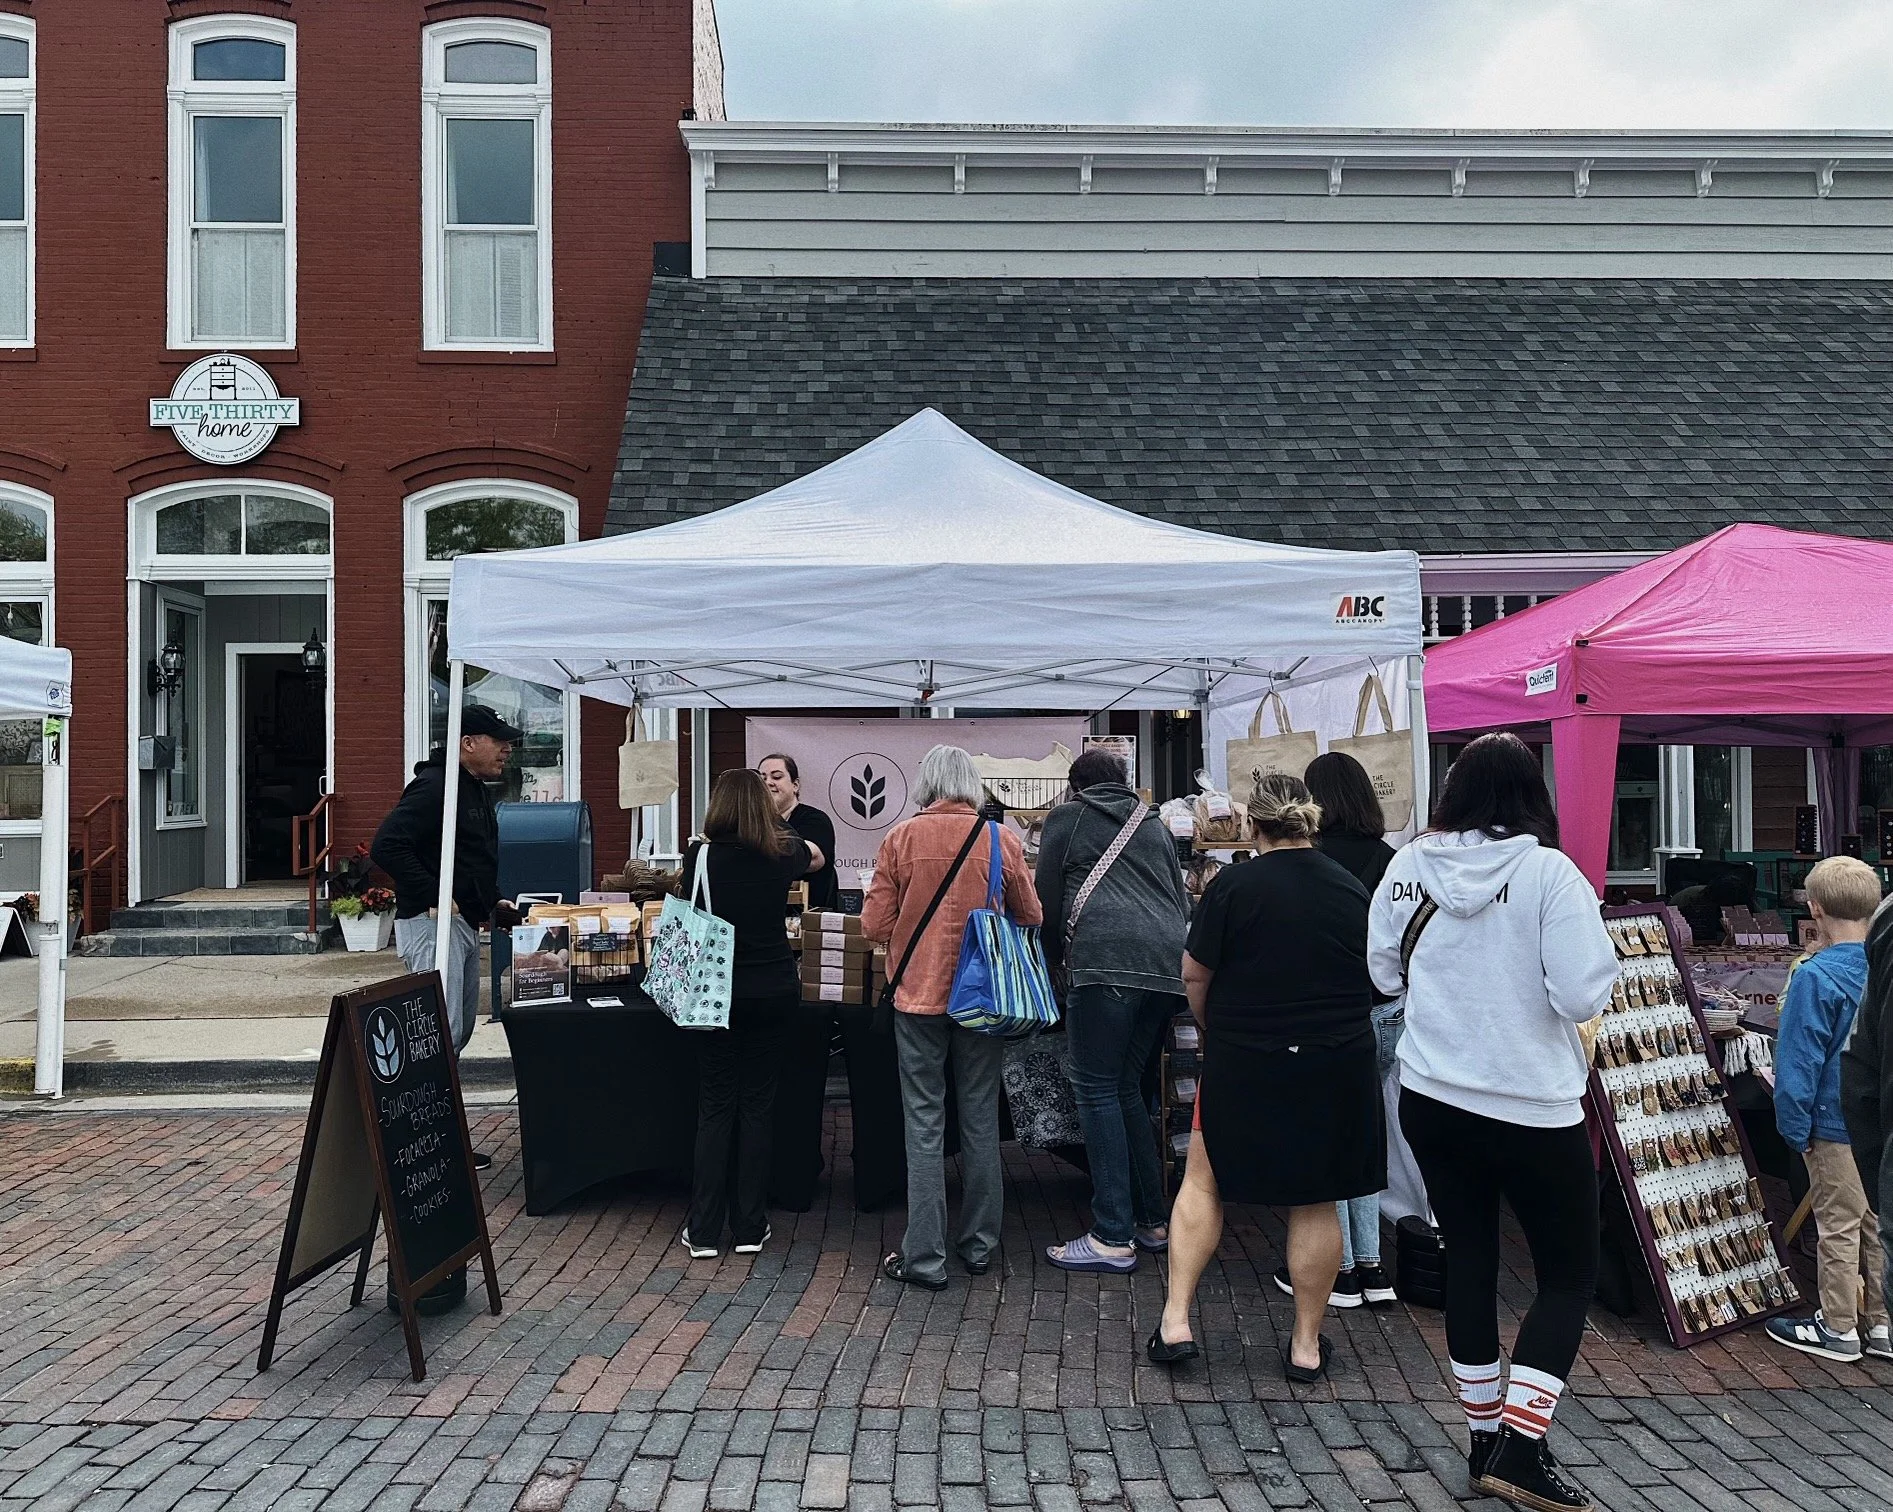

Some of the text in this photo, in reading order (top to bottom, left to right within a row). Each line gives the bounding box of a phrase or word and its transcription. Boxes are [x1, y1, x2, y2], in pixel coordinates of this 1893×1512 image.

[153, 403, 295, 420] FIVE THIRTY
[197, 413, 253, 437] home
[179, 430, 197, 447] PAINT
[1335, 596, 1385, 617] ABC
[1373, 781, 1394, 789] CIRCLE
[834, 858, 868, 868] OUGH
[1392, 881, 1429, 902] DAN
[402, 997, 426, 1020] THE
[1739, 993, 1780, 1006] rne
[406, 1013, 437, 1040] CIRCLE
[410, 1033, 440, 1062] BAKERY
